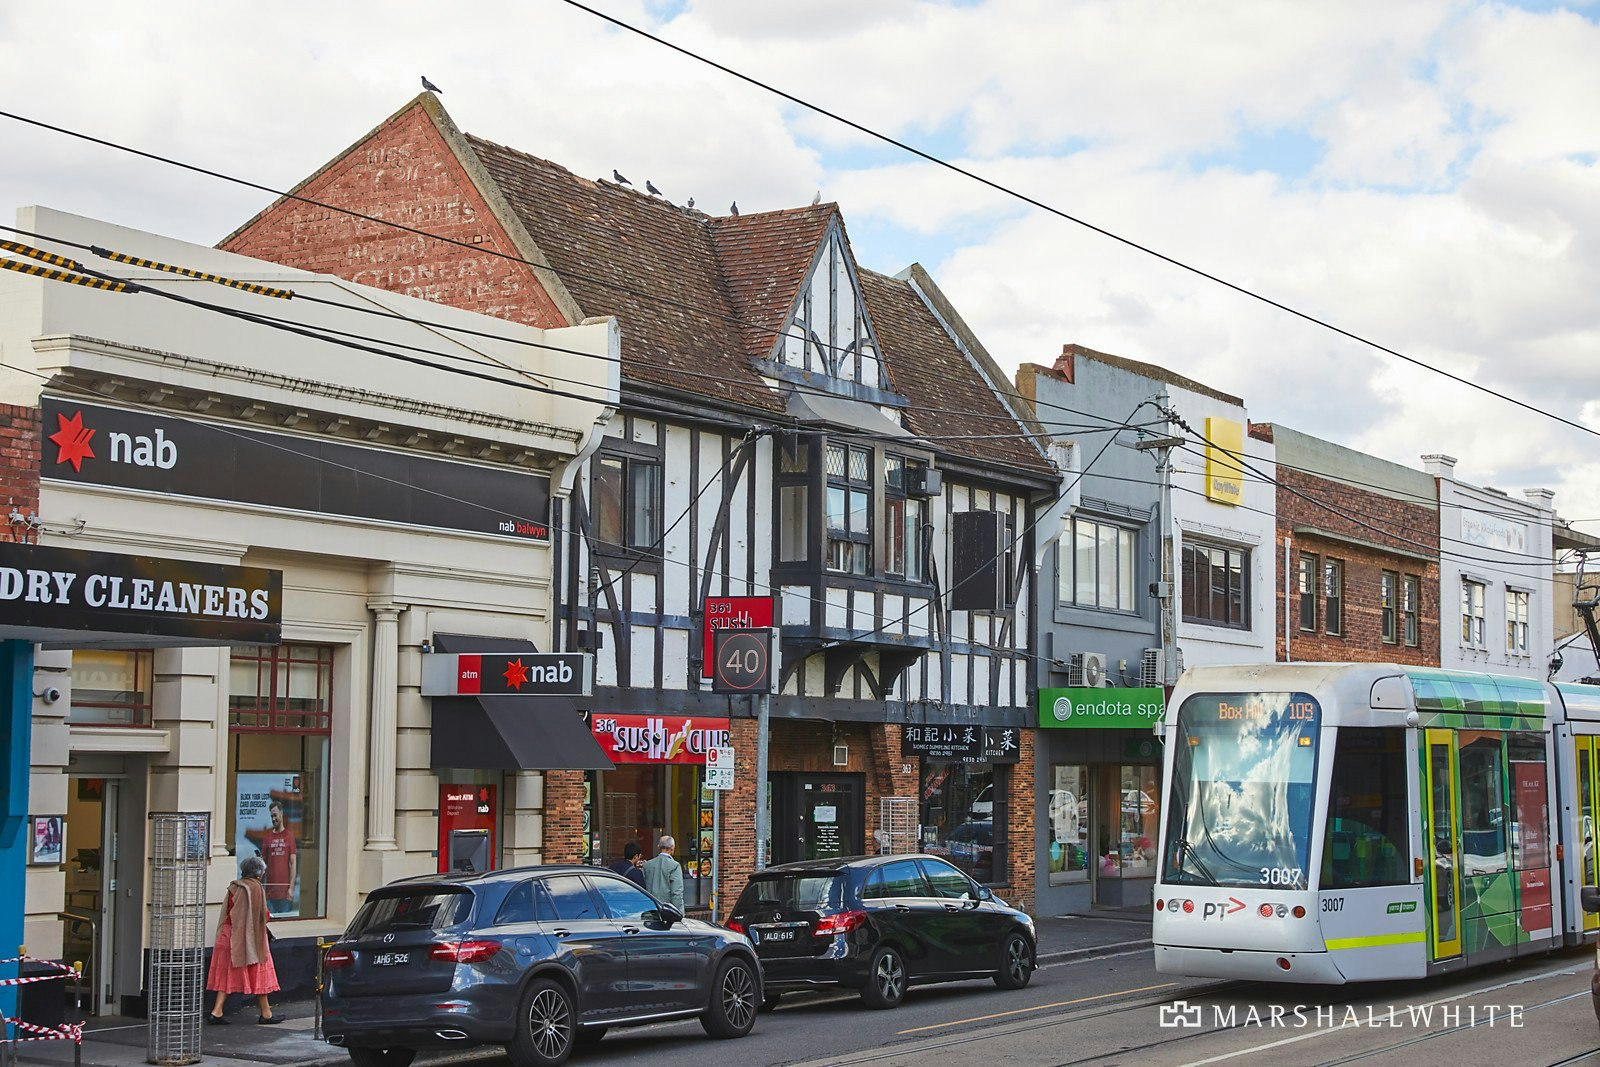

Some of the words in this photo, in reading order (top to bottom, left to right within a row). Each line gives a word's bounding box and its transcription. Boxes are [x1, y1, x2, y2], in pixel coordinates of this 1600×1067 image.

[109, 428, 177, 469] nab
[499, 520, 515, 532] nab
[516, 521, 546, 538] balwyn
[0, 567, 76, 604] DRY
[84, 574, 269, 620] CLEANERS
[709, 603, 732, 614] 361
[726, 649, 759, 674] 40
[462, 671, 478, 679] atm
[532, 660, 573, 683] nab
[1075, 700, 1131, 716] endota
[1219, 702, 1242, 720] Box
[1245, 702, 1263, 720] Hill
[1290, 702, 1313, 720] 109
[596, 719, 617, 733] 361
[905, 726, 977, 744] 和記小菜
[613, 718, 669, 759] SUSHI
[902, 764, 911, 774] 363
[477, 805, 489, 813] nab
[1260, 867, 1301, 885] 3007
[1322, 897, 1345, 912] 3007
